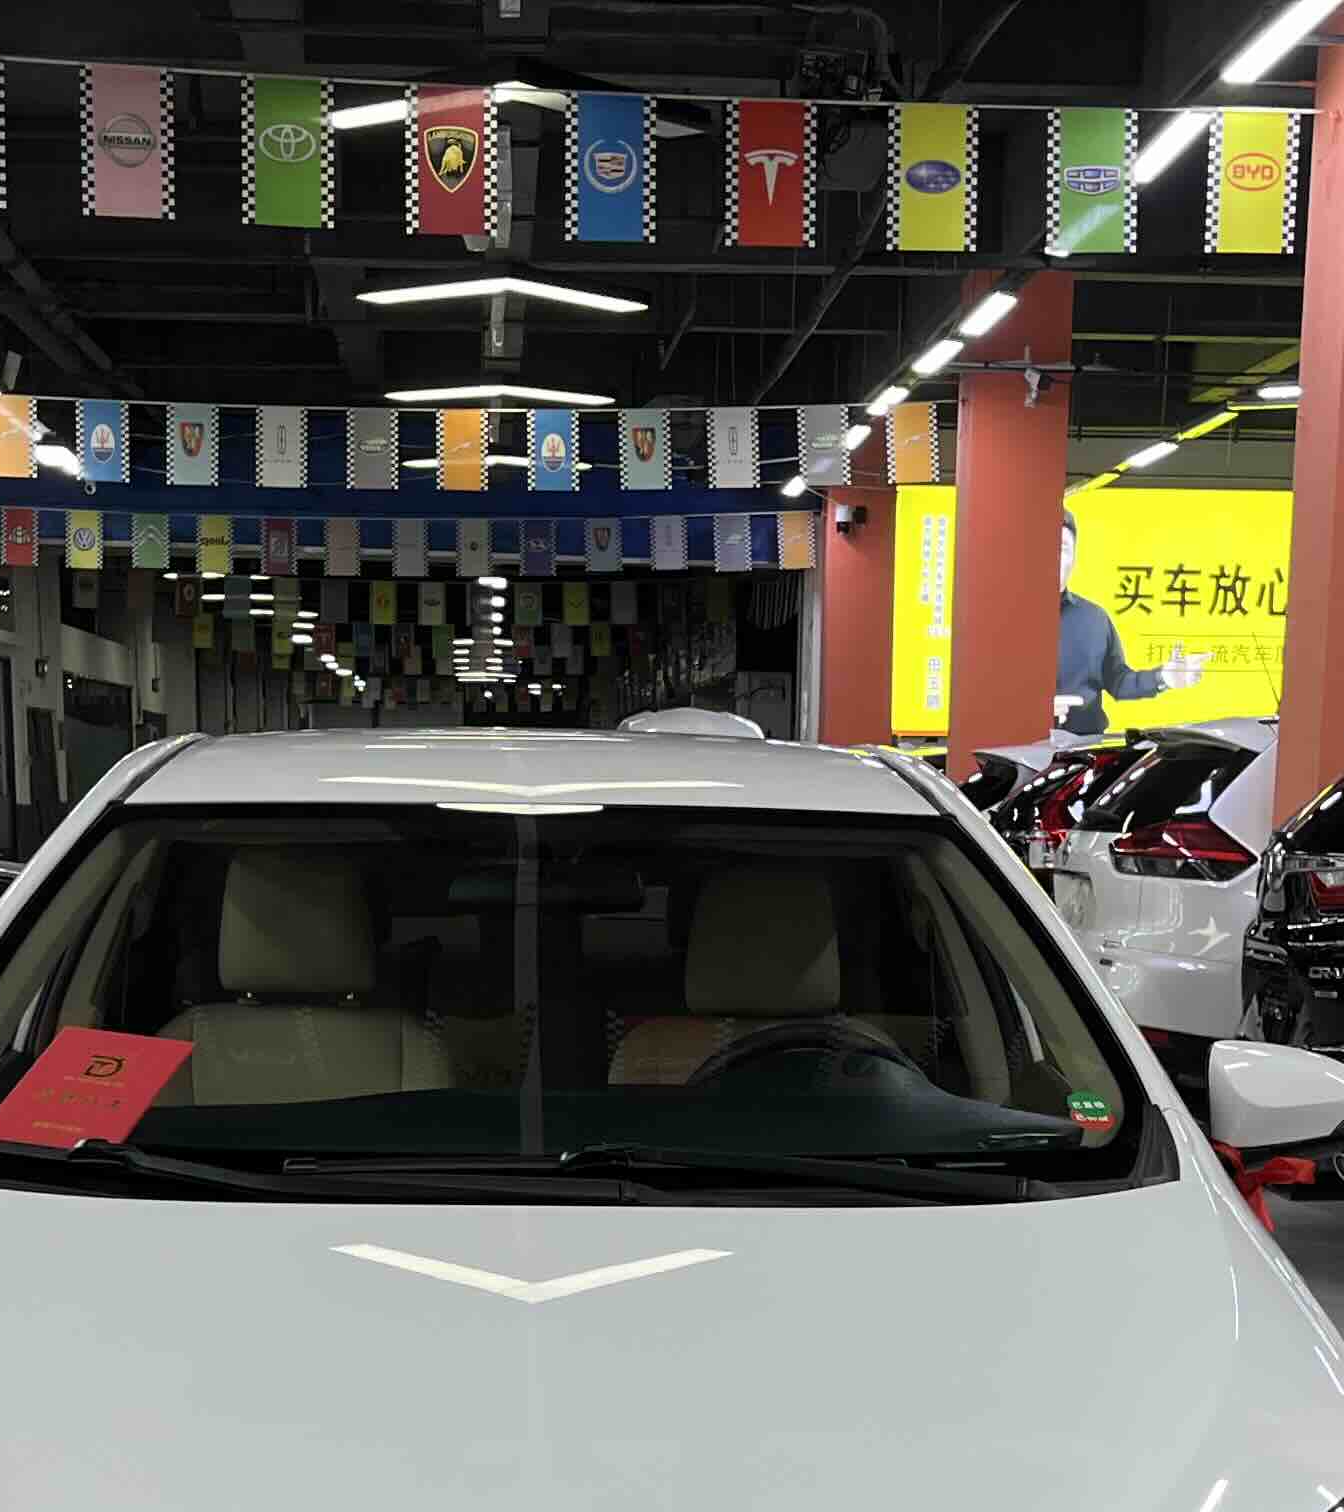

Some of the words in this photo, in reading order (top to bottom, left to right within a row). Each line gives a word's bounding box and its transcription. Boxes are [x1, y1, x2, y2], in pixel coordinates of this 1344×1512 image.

[103, 135, 152, 146] NISSAN
[1231, 164, 1273, 180] BYD
[1114, 564, 1288, 616] 买车放心
[1146, 641, 1283, 665] 打造一流汽车
